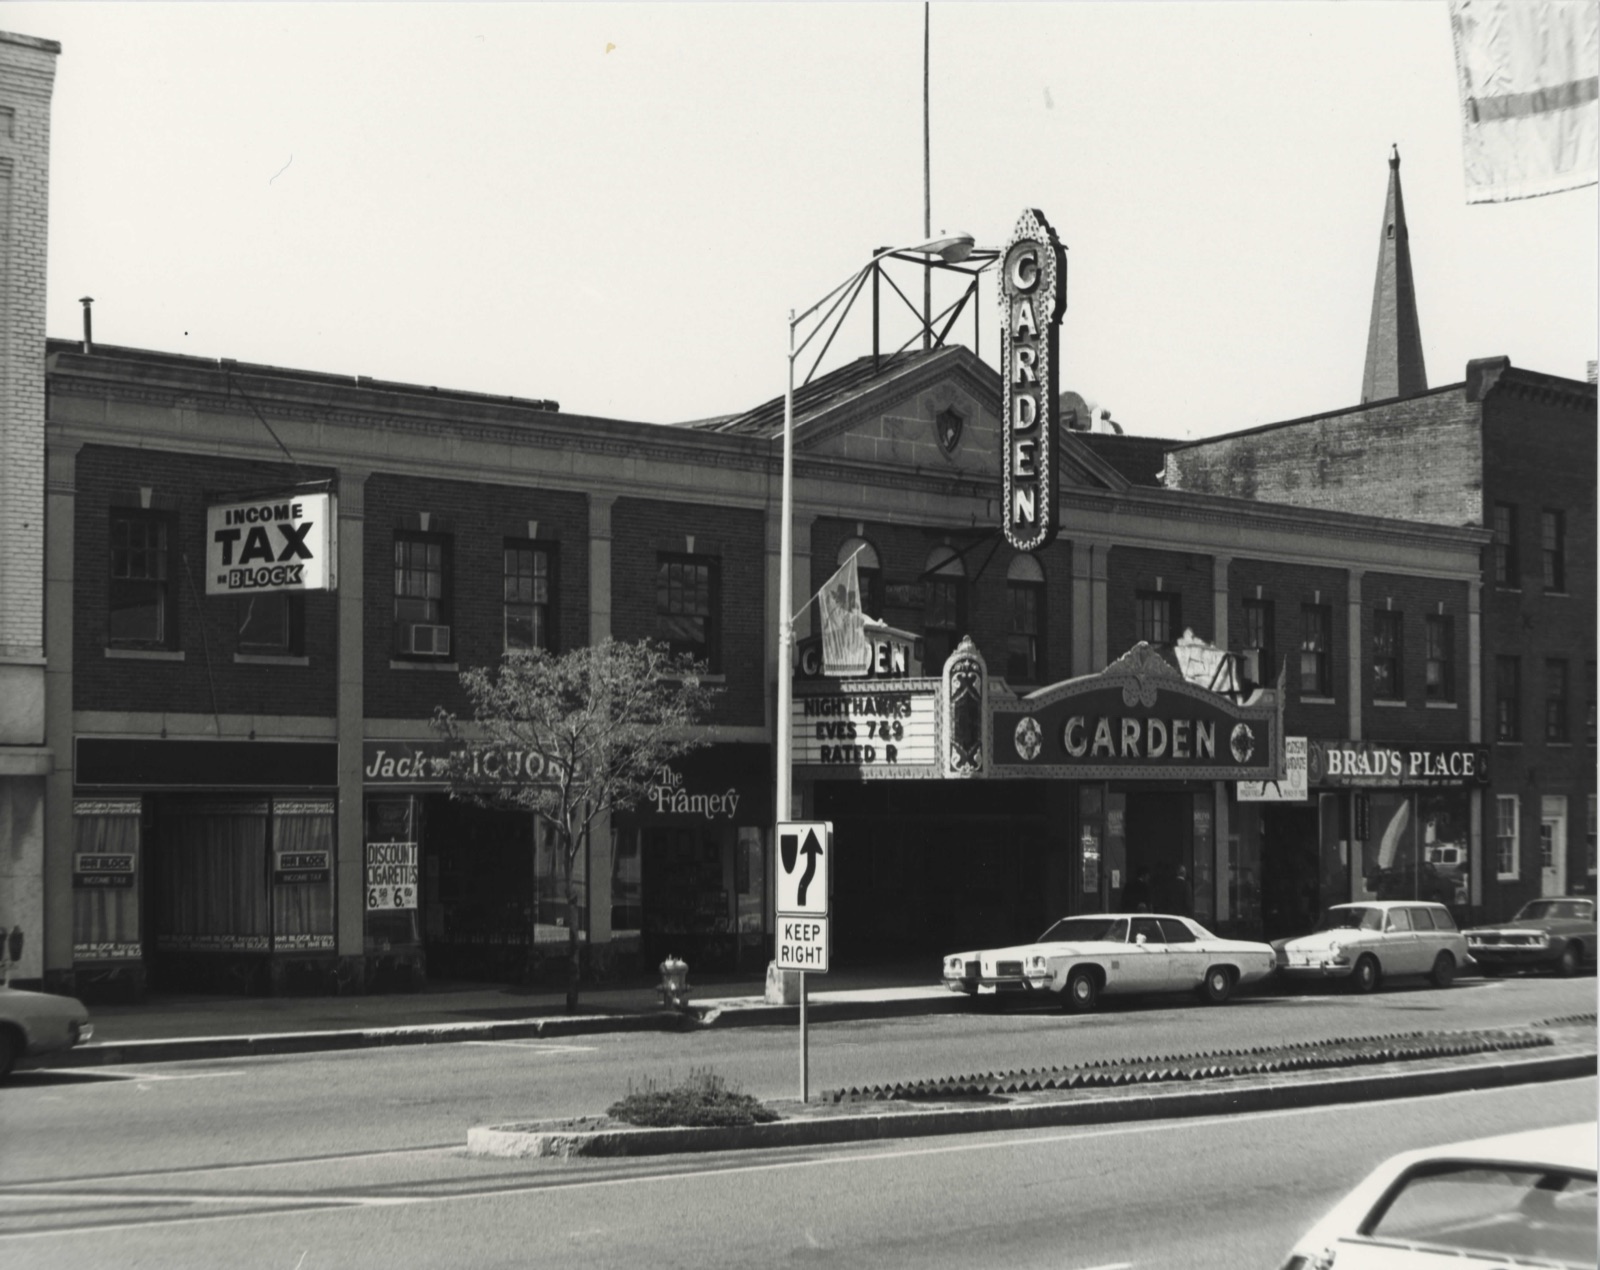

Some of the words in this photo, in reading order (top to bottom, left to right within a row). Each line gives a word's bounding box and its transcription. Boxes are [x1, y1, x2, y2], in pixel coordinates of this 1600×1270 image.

[1011, 249, 1040, 525] GARDEN
[226, 504, 303, 526] INCOME
[214, 522, 314, 566] TAX
[229, 564, 304, 589] BLOCK
[804, 696, 911, 719] NIGHTHAWKS
[816, 721, 857, 740] EVES
[1064, 716, 1215, 758] GARDEN
[821, 744, 876, 763] RATED
[886, 744, 898, 763] R
[1327, 749, 1402, 776] BRAD'S
[1409, 751, 1475, 776] PLACE
[656, 763, 683, 788] The
[648, 784, 740, 820] Framery
[368, 845, 417, 864] DISCOUNT
[785, 923, 821, 942] KEEP
[781, 945, 822, 964] RIGHT
